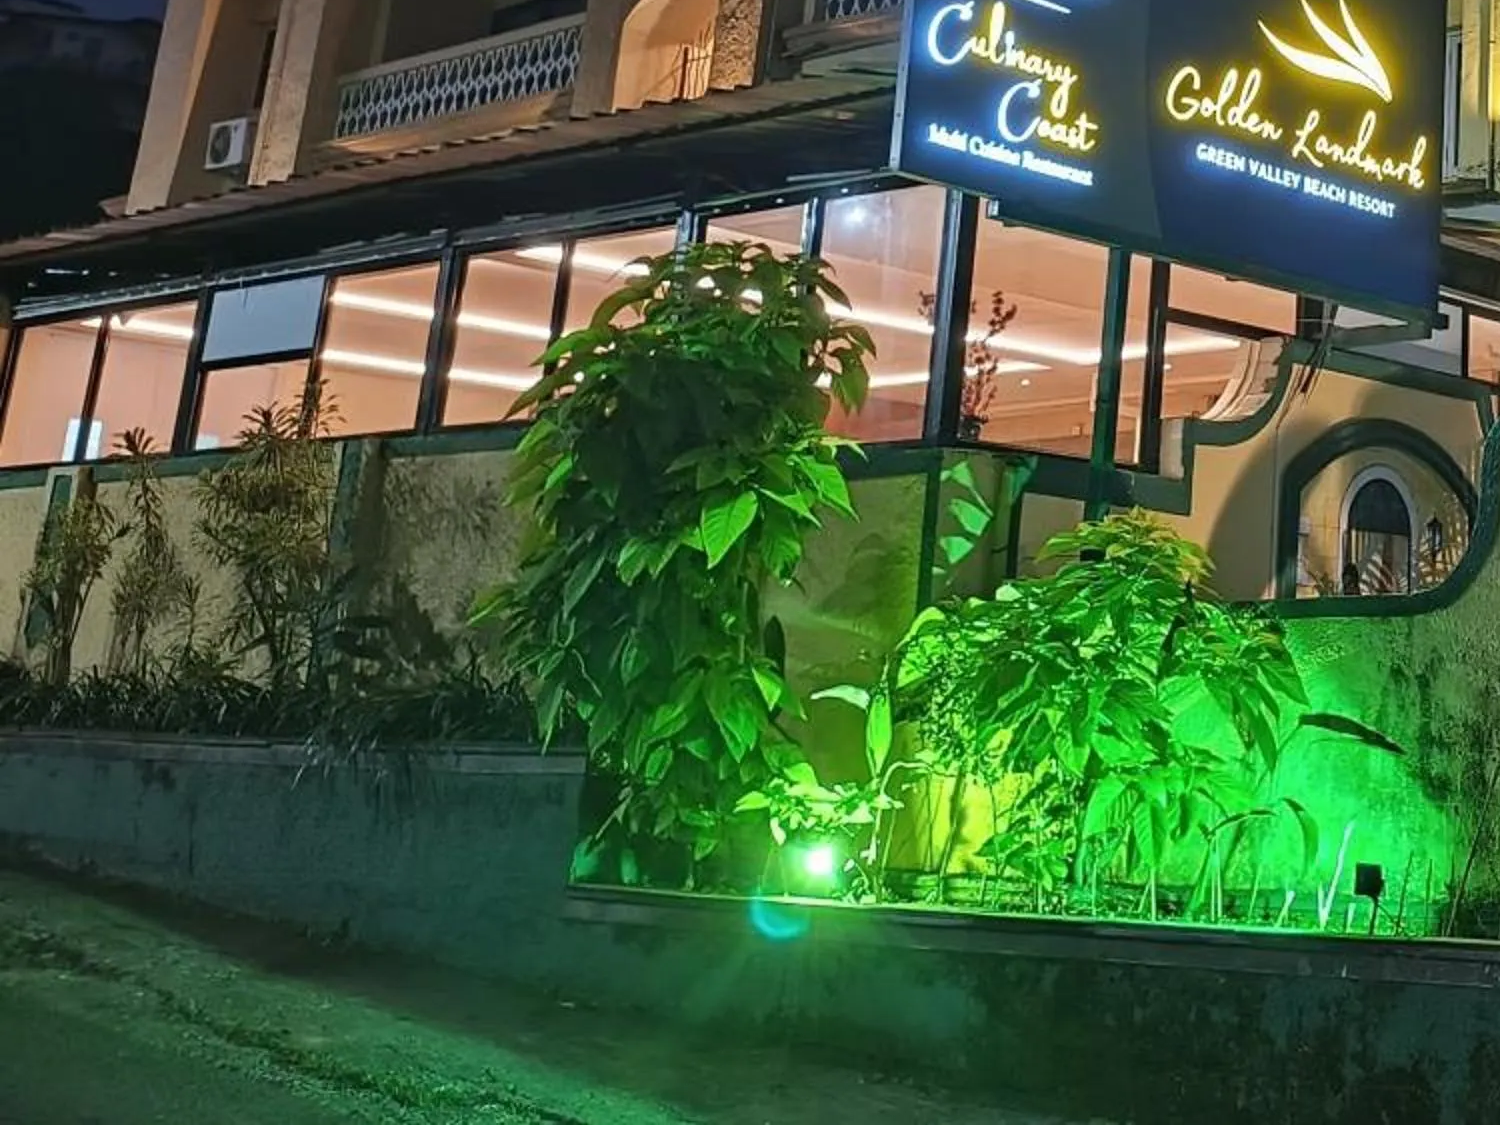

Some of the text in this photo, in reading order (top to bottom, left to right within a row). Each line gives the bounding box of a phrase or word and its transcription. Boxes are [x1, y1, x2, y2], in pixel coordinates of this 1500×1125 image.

[928, 0, 1078, 119] Culinary
[997, 78, 1100, 152] Coast
[1166, 66, 1427, 190] Golden Landmark
[1196, 143, 1396, 219] GREEN VALLEY BEACH RESORT
